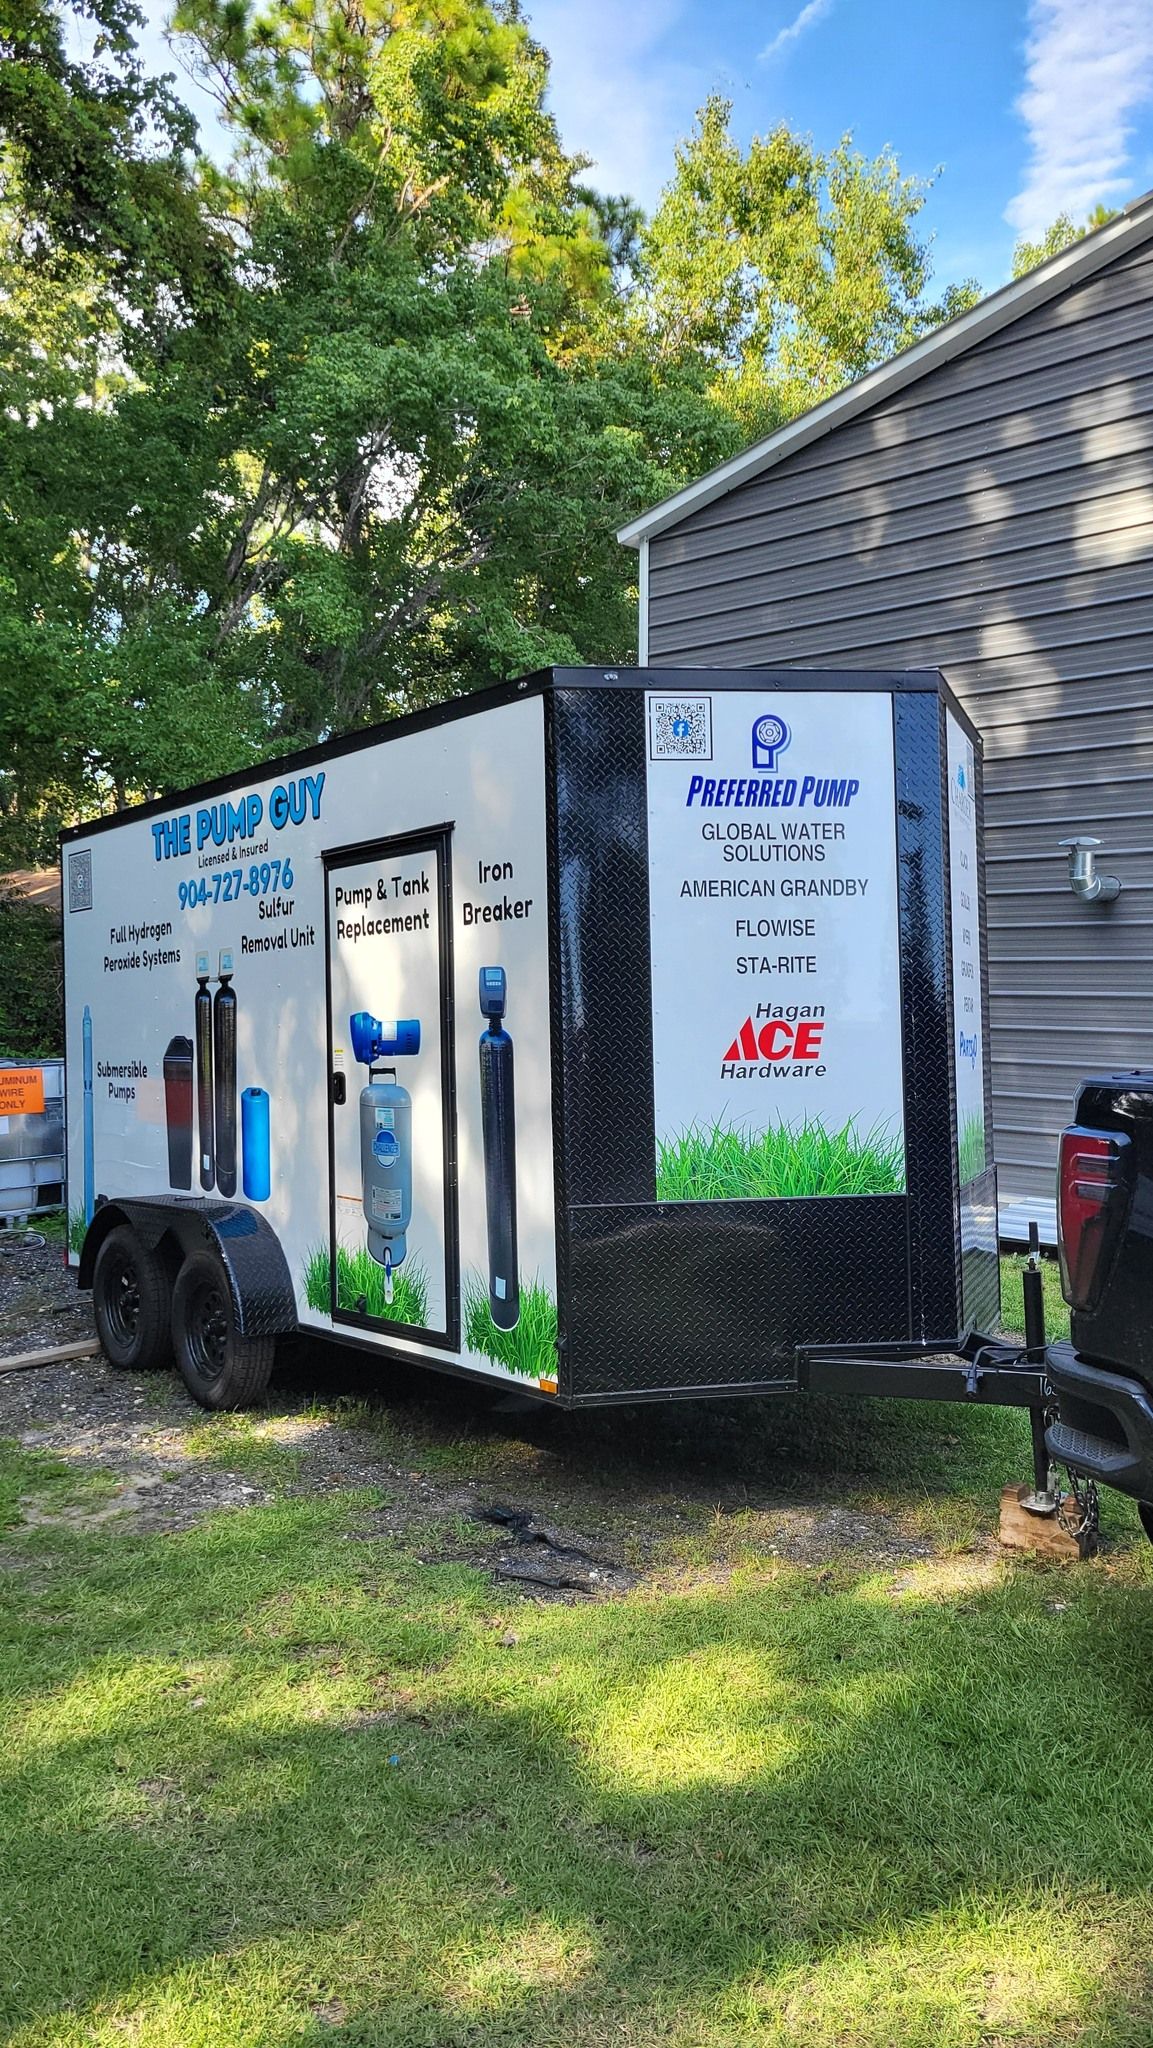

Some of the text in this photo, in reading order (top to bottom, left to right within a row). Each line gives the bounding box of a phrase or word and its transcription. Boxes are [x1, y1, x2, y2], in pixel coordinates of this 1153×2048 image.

[686, 775, 860, 807] PREFERRED PUMP
[152, 772, 326, 861] THE PUMP GUY
[702, 823, 845, 840] GLOBAL WATER
[198, 839, 268, 868] Licensed & Insured
[723, 844, 825, 862] SOLUTIONS
[478, 860, 513, 884] Iron
[179, 858, 294, 910] 904-727-8976
[335, 871, 429, 908] Pump & Tank
[680, 879, 869, 897] AMERICAN GRANDBY
[258, 896, 295, 920] Sulfur
[463, 896, 533, 926] Breaker
[110, 921, 172, 945] Full Hydrogen
[337, 908, 430, 943] Replacement
[736, 919, 815, 937] FLOWISE
[241, 925, 315, 954] Removal Unit
[104, 949, 181, 972] Peroxide Systems
[736, 956, 817, 974] STA-RITE
[756, 1003, 825, 1022] Hagan
[723, 1016, 824, 1061] ACE
[97, 1061, 147, 1079] Submersible
[721, 1063, 826, 1079] Hardware
[0, 1088, 24, 1097] WIRE
[108, 1083, 136, 1103] Pumps
[0, 1100, 26, 1110] ONLY
